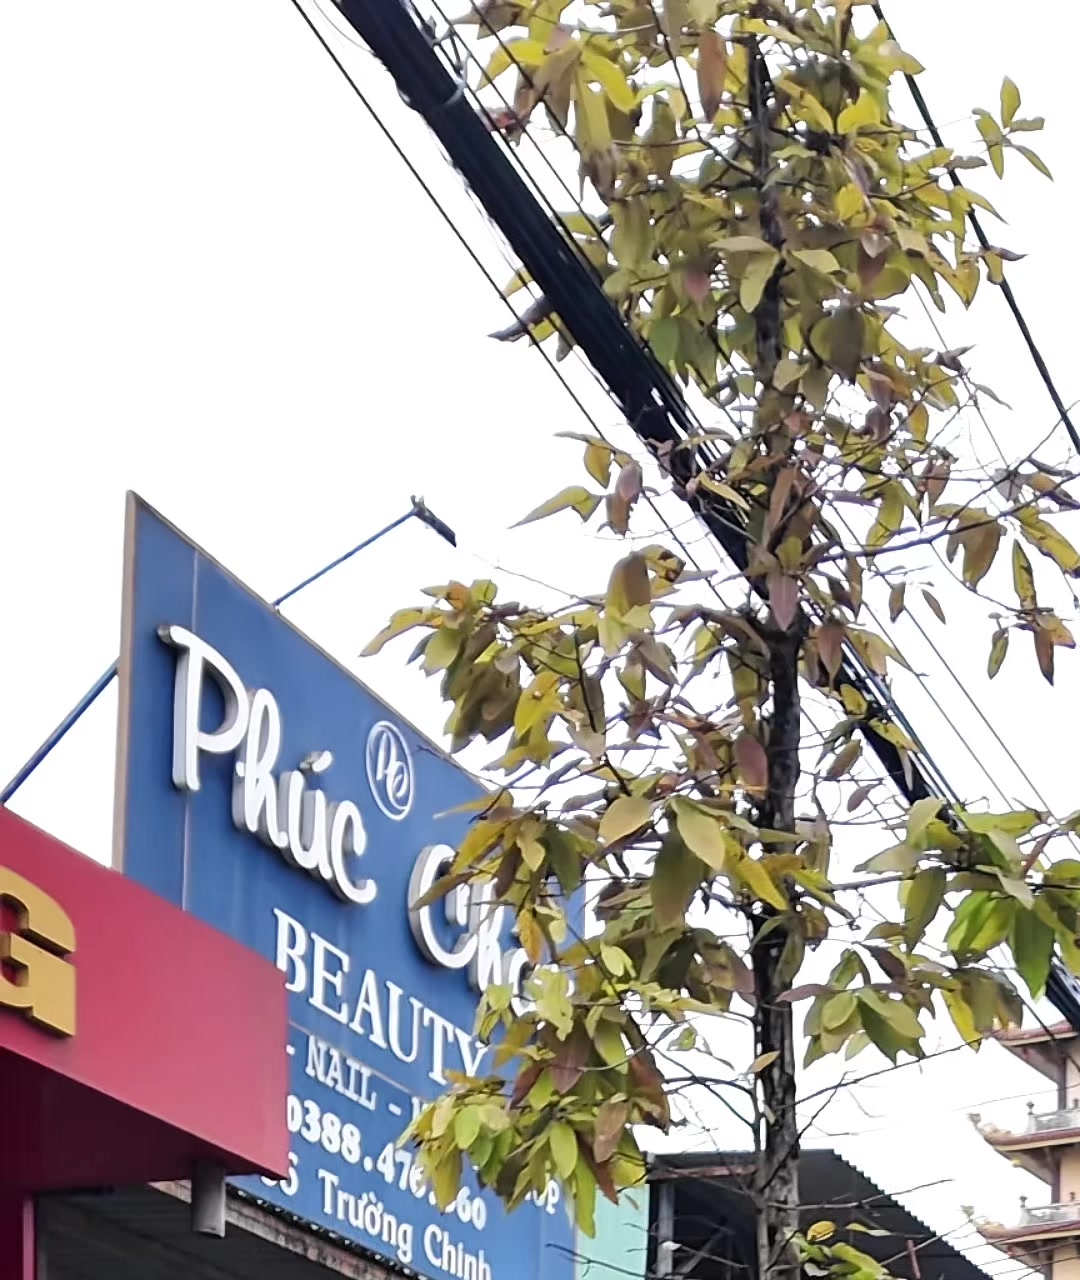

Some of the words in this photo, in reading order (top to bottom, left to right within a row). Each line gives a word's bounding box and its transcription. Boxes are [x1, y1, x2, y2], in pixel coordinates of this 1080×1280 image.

[158, 625, 377, 903] Phúc
[273, 908, 489, 1085] BEAUTY
[305, 1035, 376, 1110] NAIL
[287, 1095, 486, 1231] 0388.476.60
[318, 1168, 413, 1264] Trường
